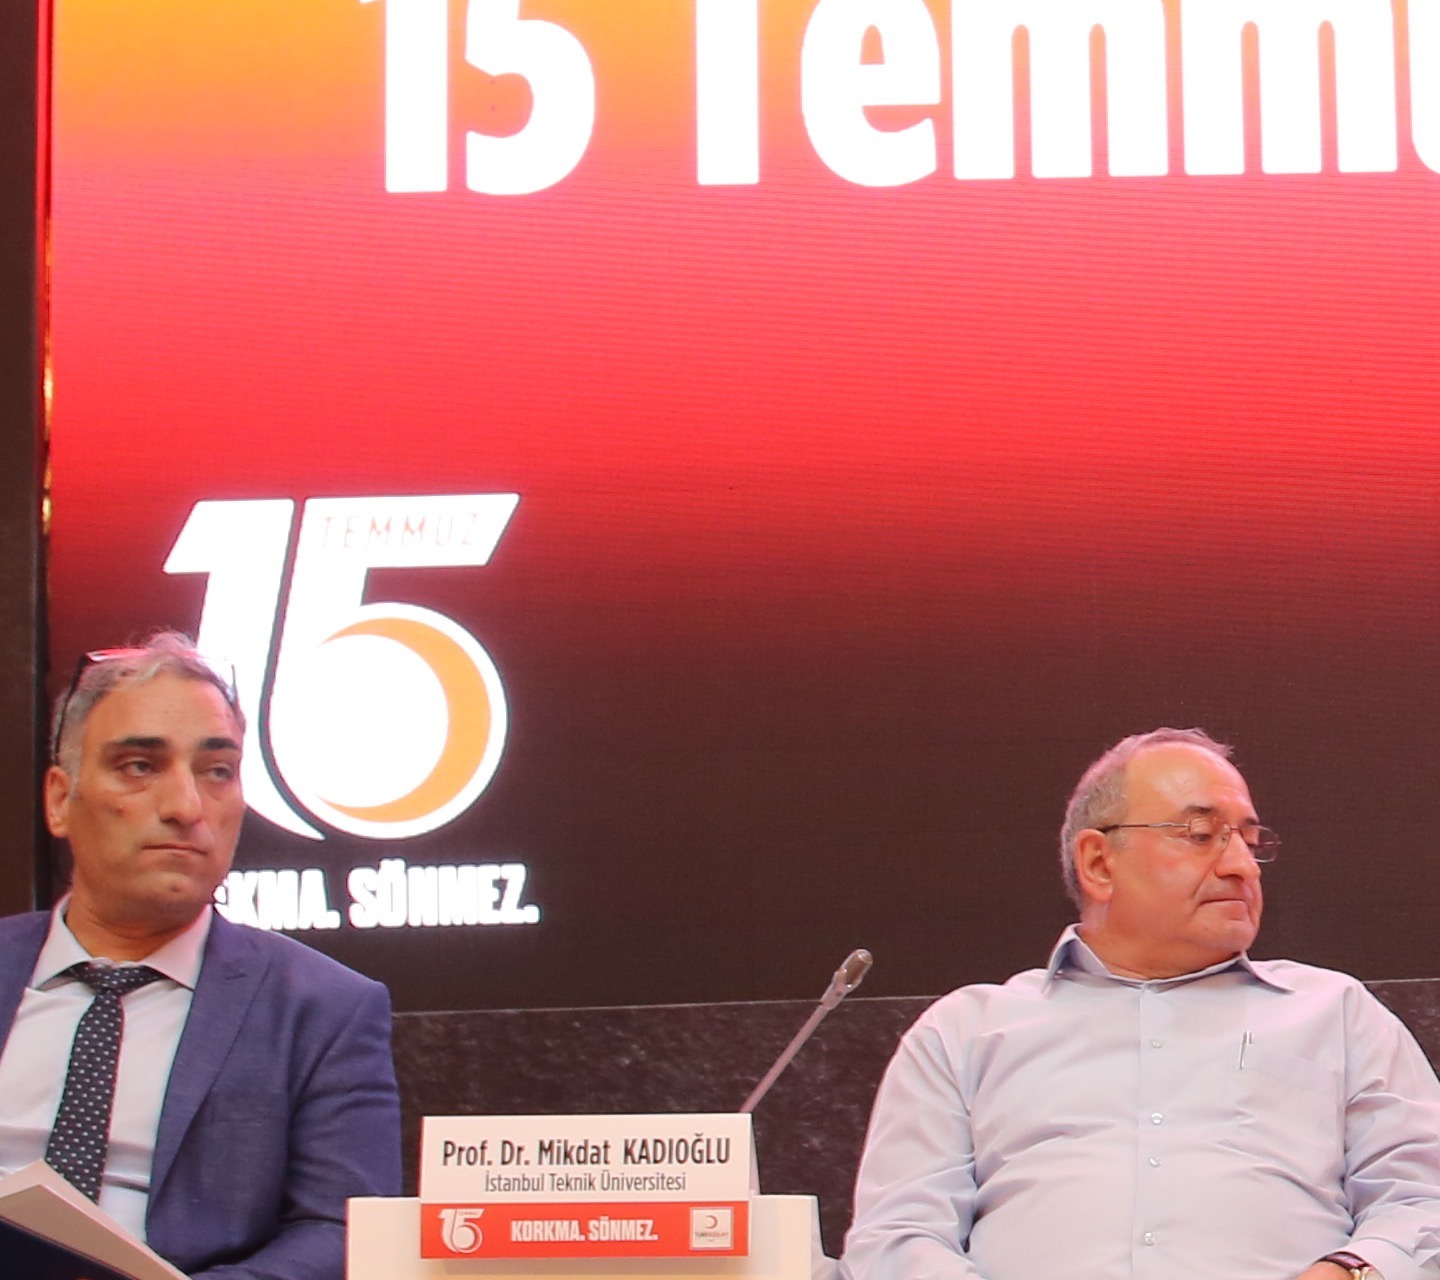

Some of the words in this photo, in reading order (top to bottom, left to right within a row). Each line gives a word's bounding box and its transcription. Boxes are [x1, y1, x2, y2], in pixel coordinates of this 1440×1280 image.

[320, 513, 478, 549] TEMMUZ
[347, 858, 540, 928] SÖNMEZ.
[442, 1140, 493, 1166] Prof.
[500, 1140, 530, 1166] Dr.
[538, 1139, 610, 1166] Mikdat
[623, 1133, 731, 1165] KADIOĞLU
[485, 1170, 544, 1192] İstanbul
[549, 1173, 596, 1192] Teknik
[600, 1169, 686, 1192] Üniversitesi
[511, 1220, 586, 1242] KORKMA.
[588, 1216, 659, 1241] SÖNMEZ.
